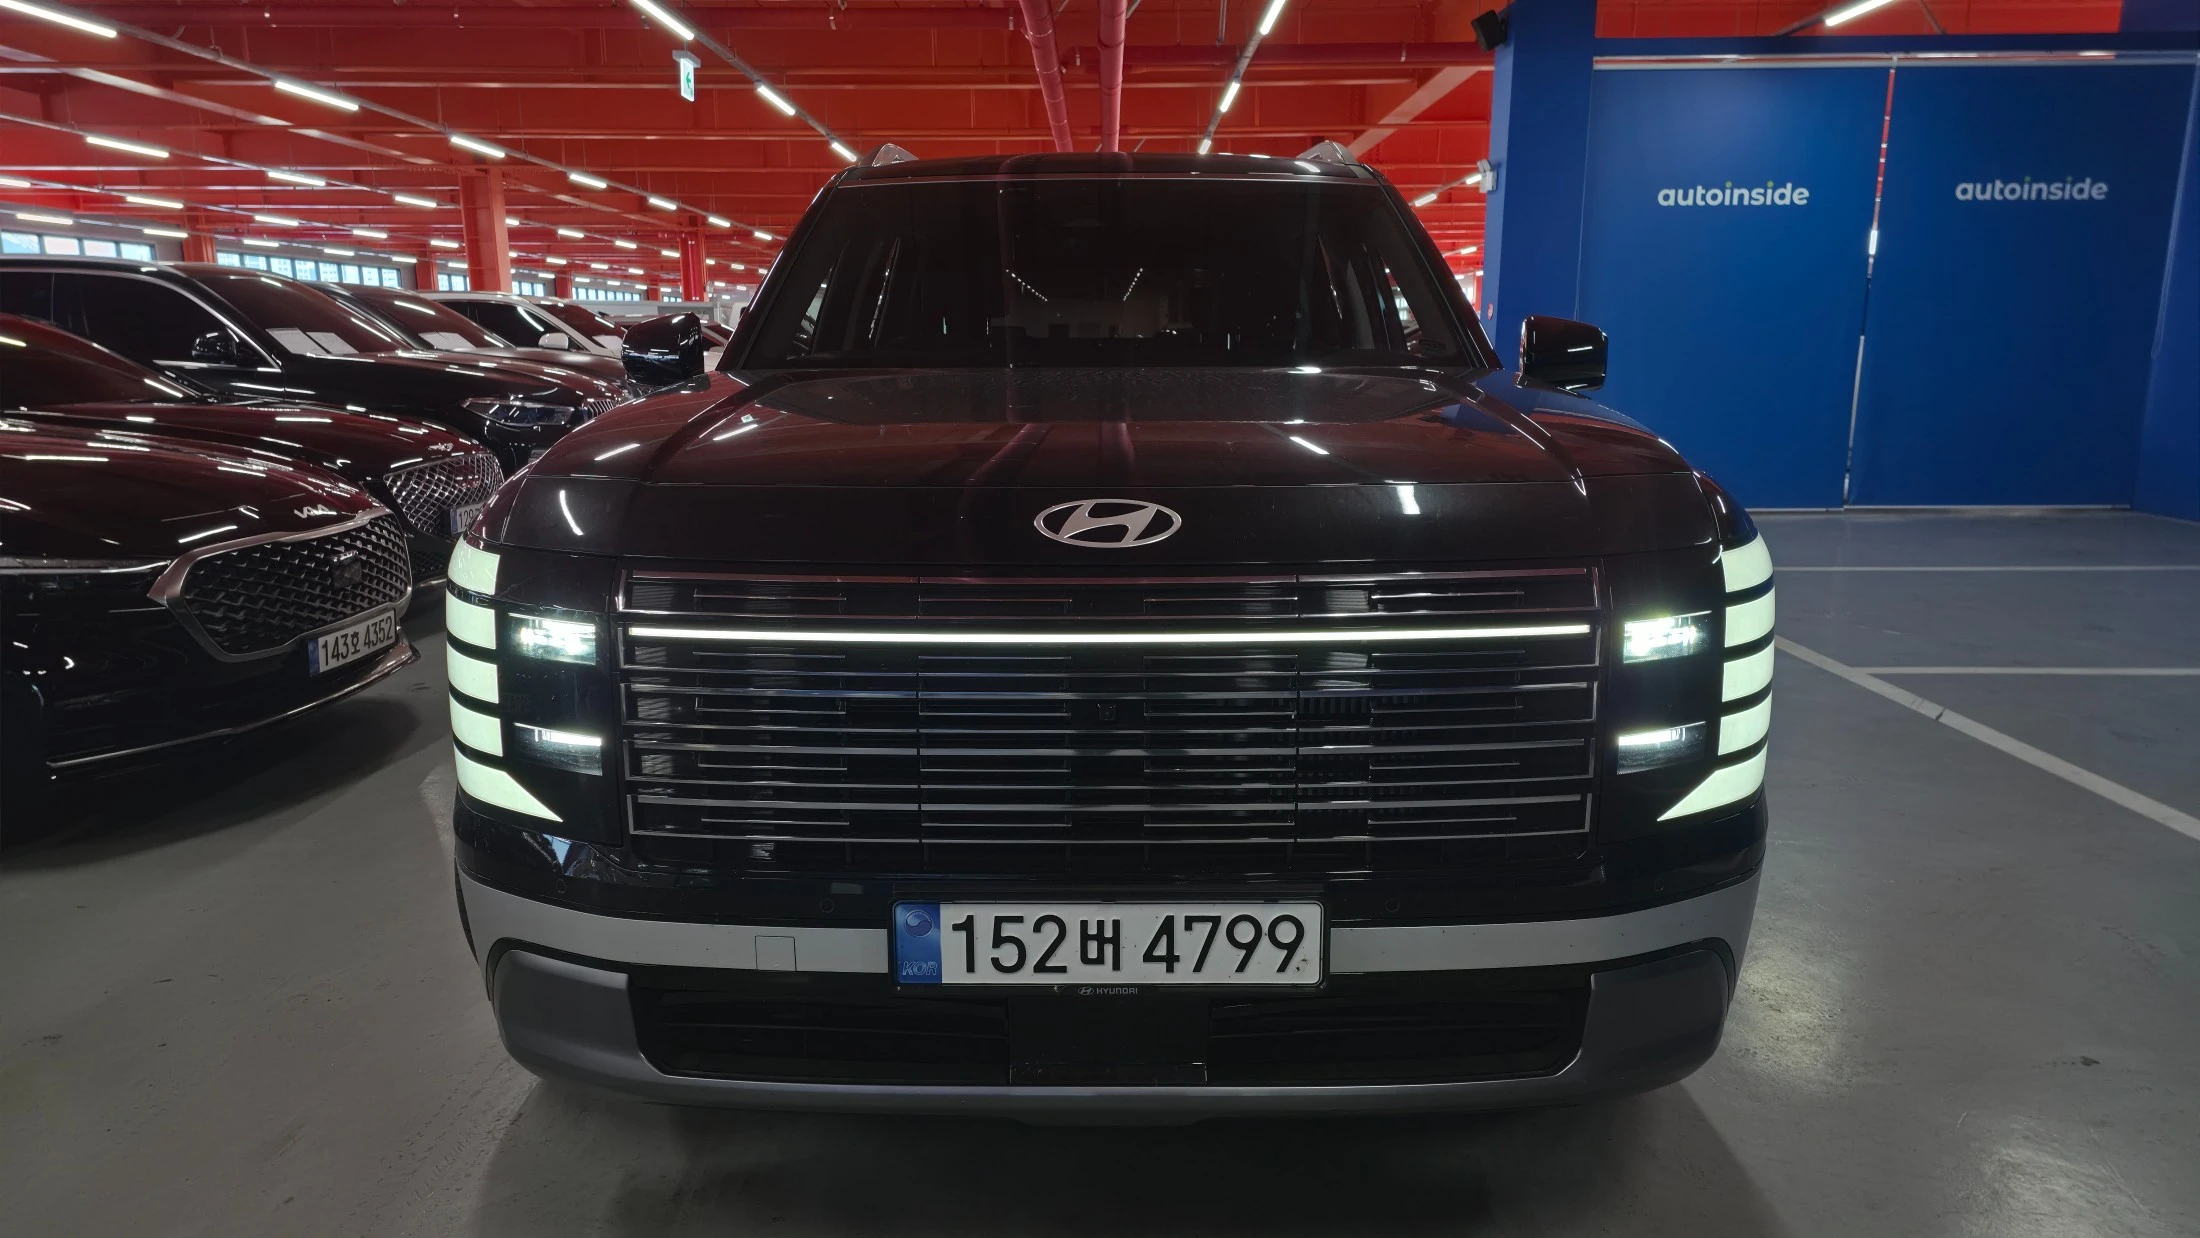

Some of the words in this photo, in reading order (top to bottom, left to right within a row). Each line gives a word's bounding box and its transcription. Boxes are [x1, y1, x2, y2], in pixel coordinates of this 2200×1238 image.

[1657, 180, 1810, 206] autoinside
[1955, 175, 2108, 201] autoinside
[322, 631, 360, 666] 143호
[364, 616, 393, 649] 4352
[952, 914, 1121, 974] 152버
[1142, 914, 1305, 974] 4799
[902, 961, 938, 976] KOR
[1096, 987, 1138, 995] HYUNDAI
